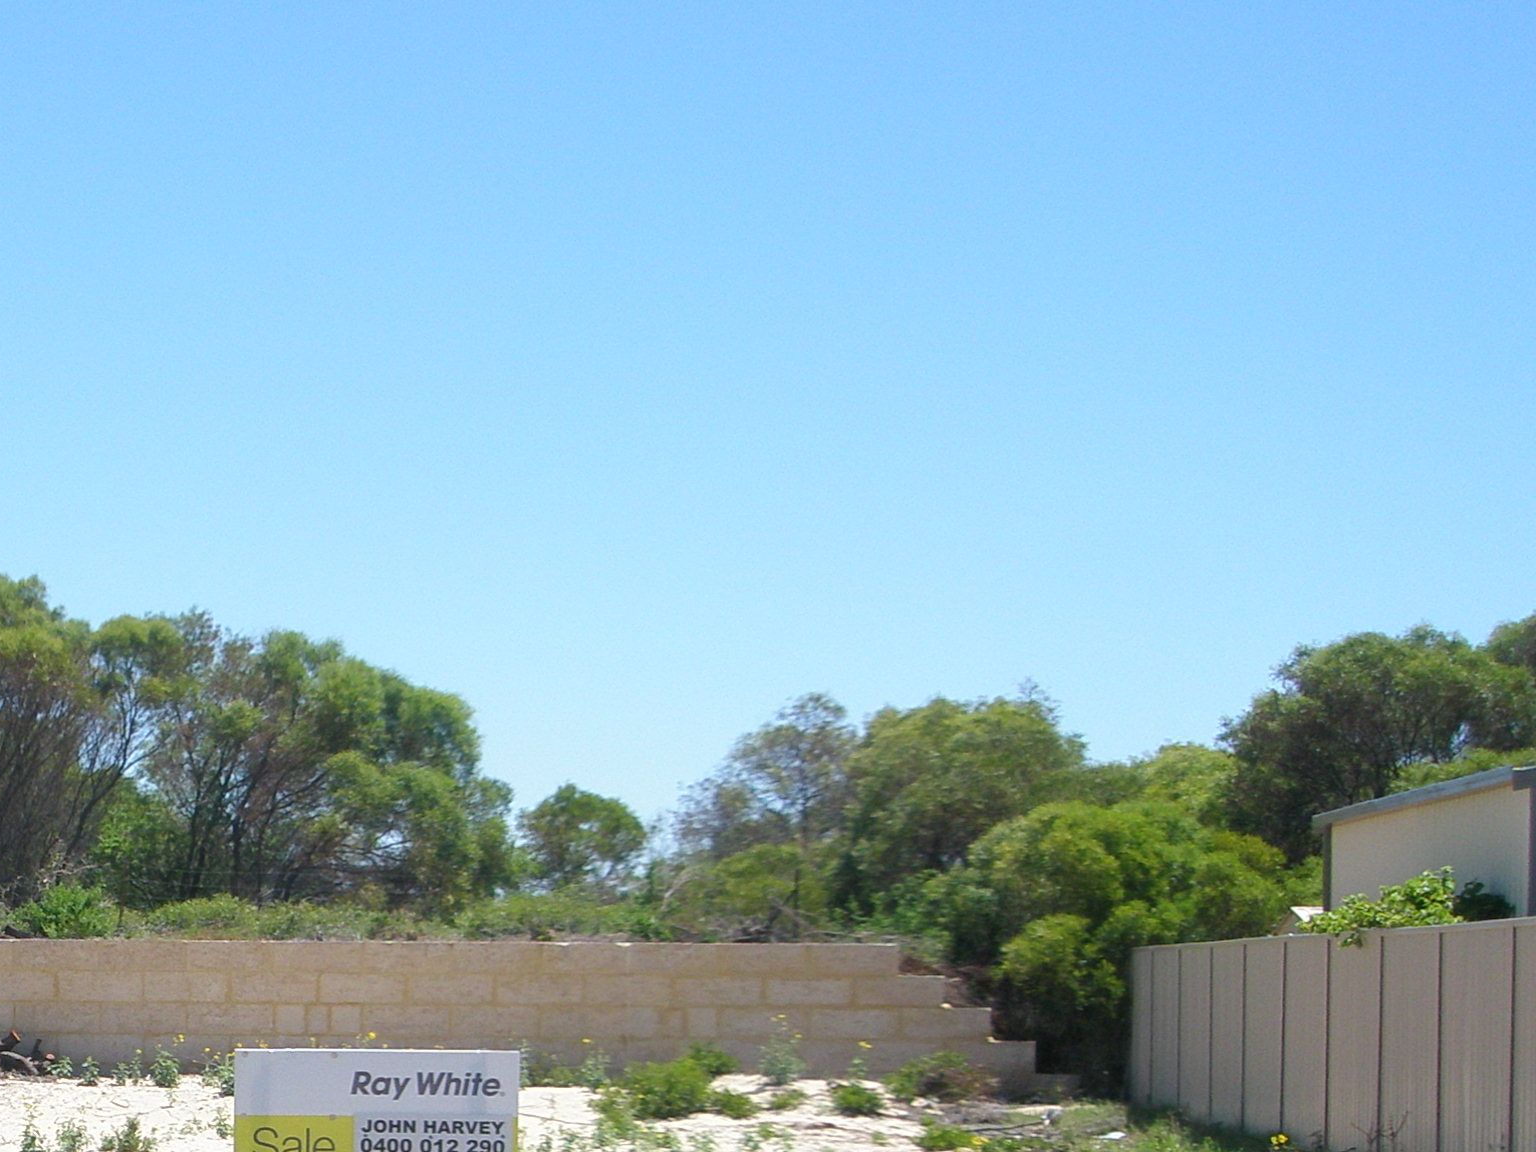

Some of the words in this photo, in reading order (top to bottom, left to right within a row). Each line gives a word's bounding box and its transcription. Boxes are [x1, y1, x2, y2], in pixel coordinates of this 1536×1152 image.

[350, 1071, 411, 1100] Ray
[417, 1071, 501, 1097] White
[360, 1119, 416, 1134] JOHN
[423, 1120, 505, 1135] HARVEY
